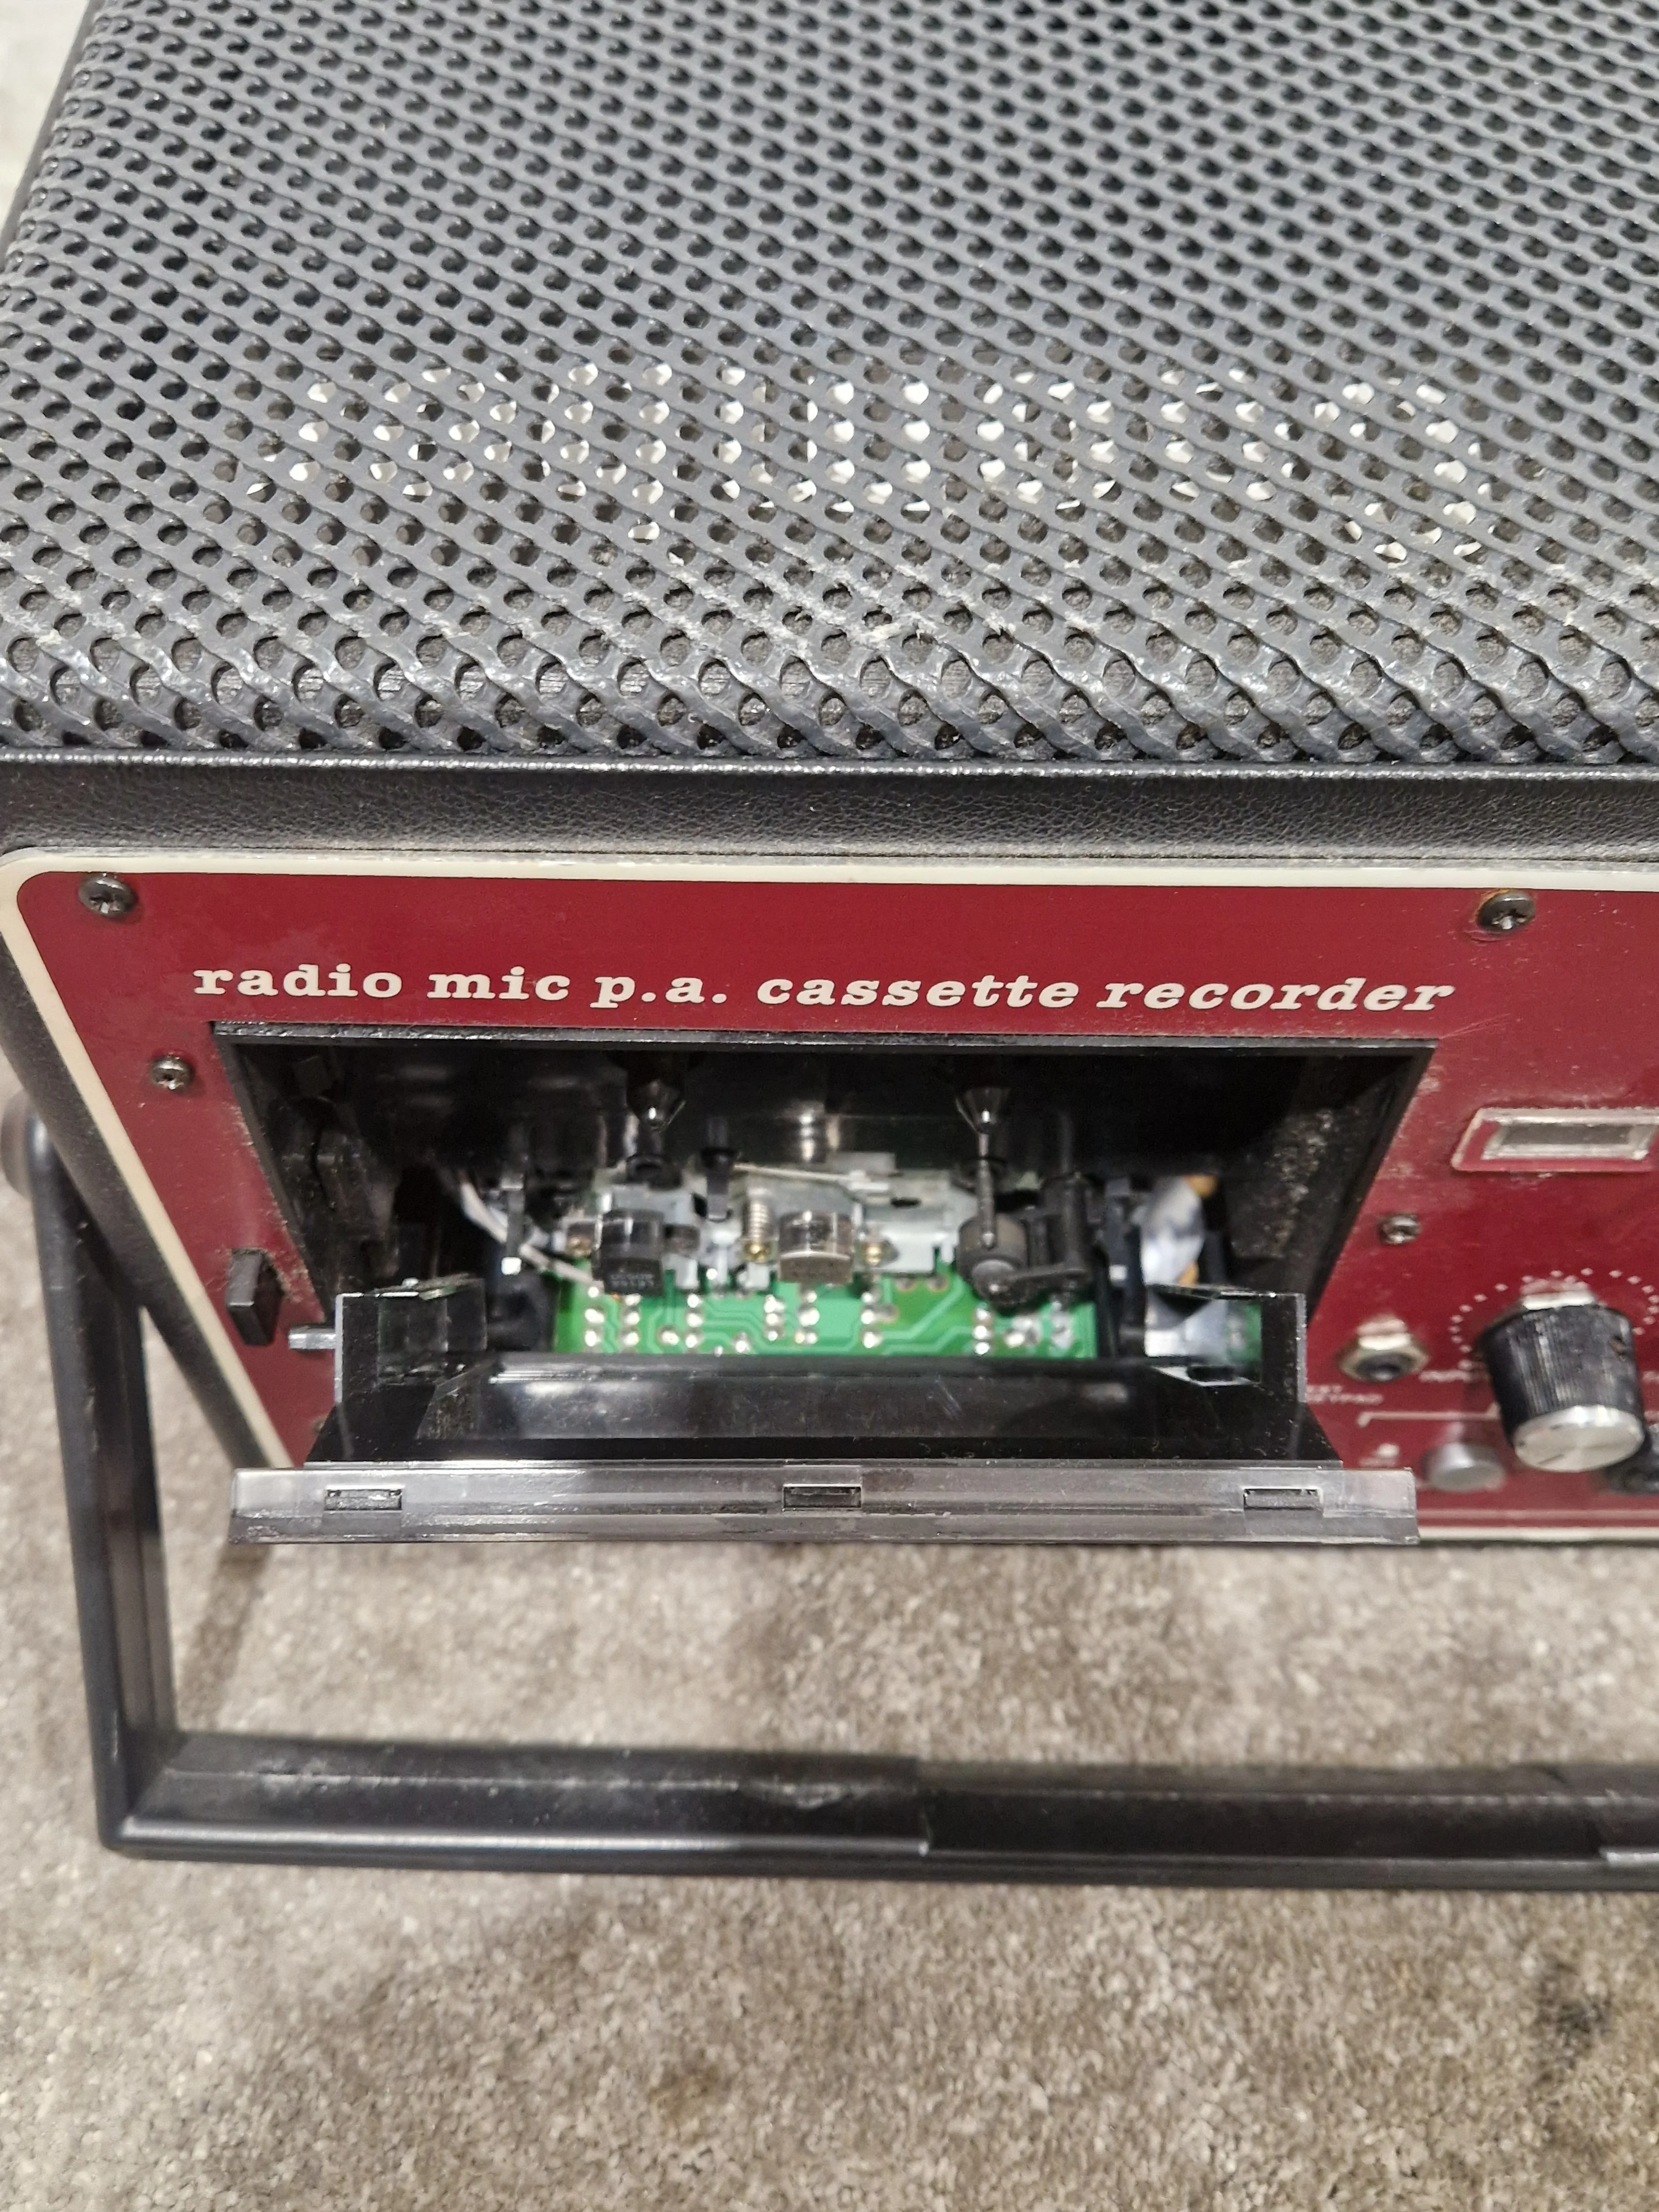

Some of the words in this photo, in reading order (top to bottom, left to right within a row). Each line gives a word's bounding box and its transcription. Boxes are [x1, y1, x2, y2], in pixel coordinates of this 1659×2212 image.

[192, 963, 403, 998] radio
[426, 966, 571, 1001] mic
[589, 976, 727, 1009] p.a.
[757, 974, 1079, 1008] cassette
[1095, 977, 1455, 1011] recorder
